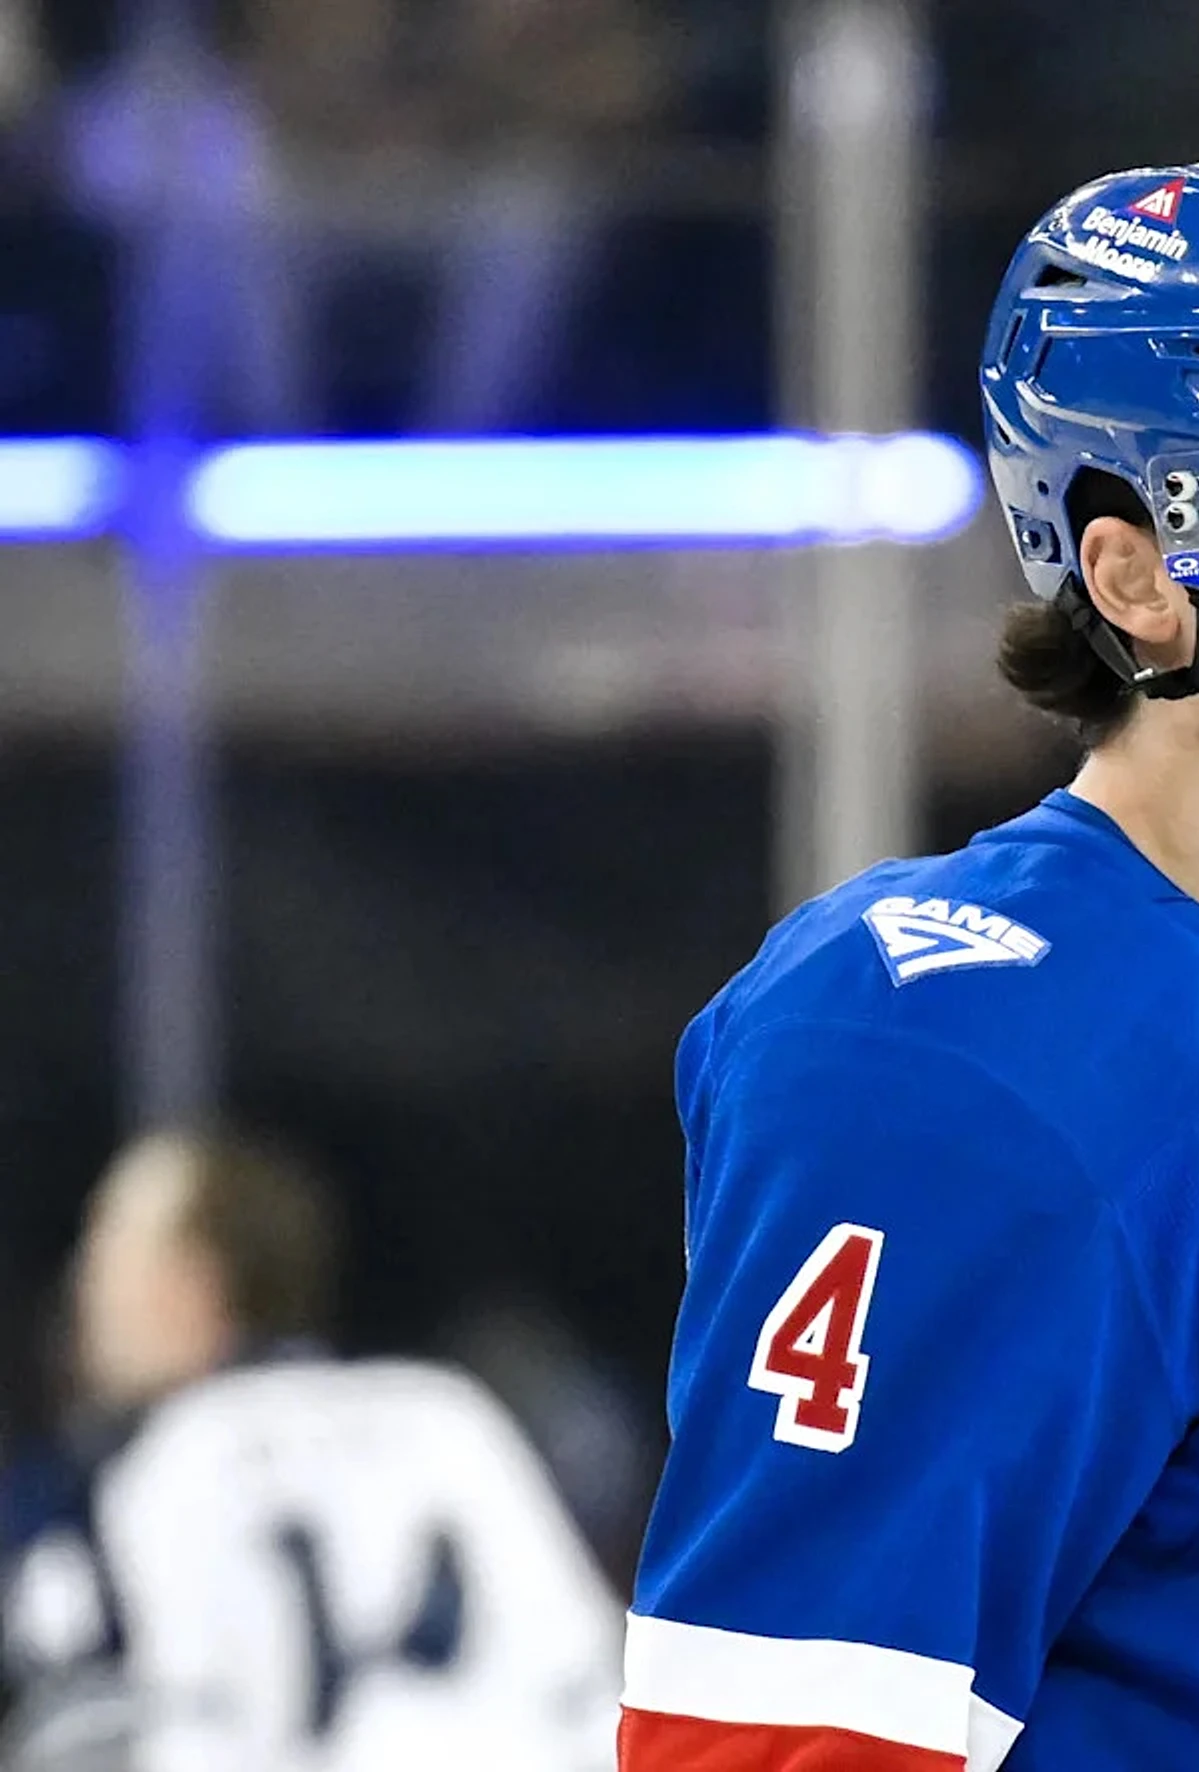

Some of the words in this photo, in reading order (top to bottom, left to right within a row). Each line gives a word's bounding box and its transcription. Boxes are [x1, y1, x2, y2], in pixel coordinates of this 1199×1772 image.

[1082, 206, 1188, 261] Benjamin
[1084, 236, 1156, 283] Moore
[866, 896, 1046, 961] GAME
[748, 1222, 884, 1453] 4
